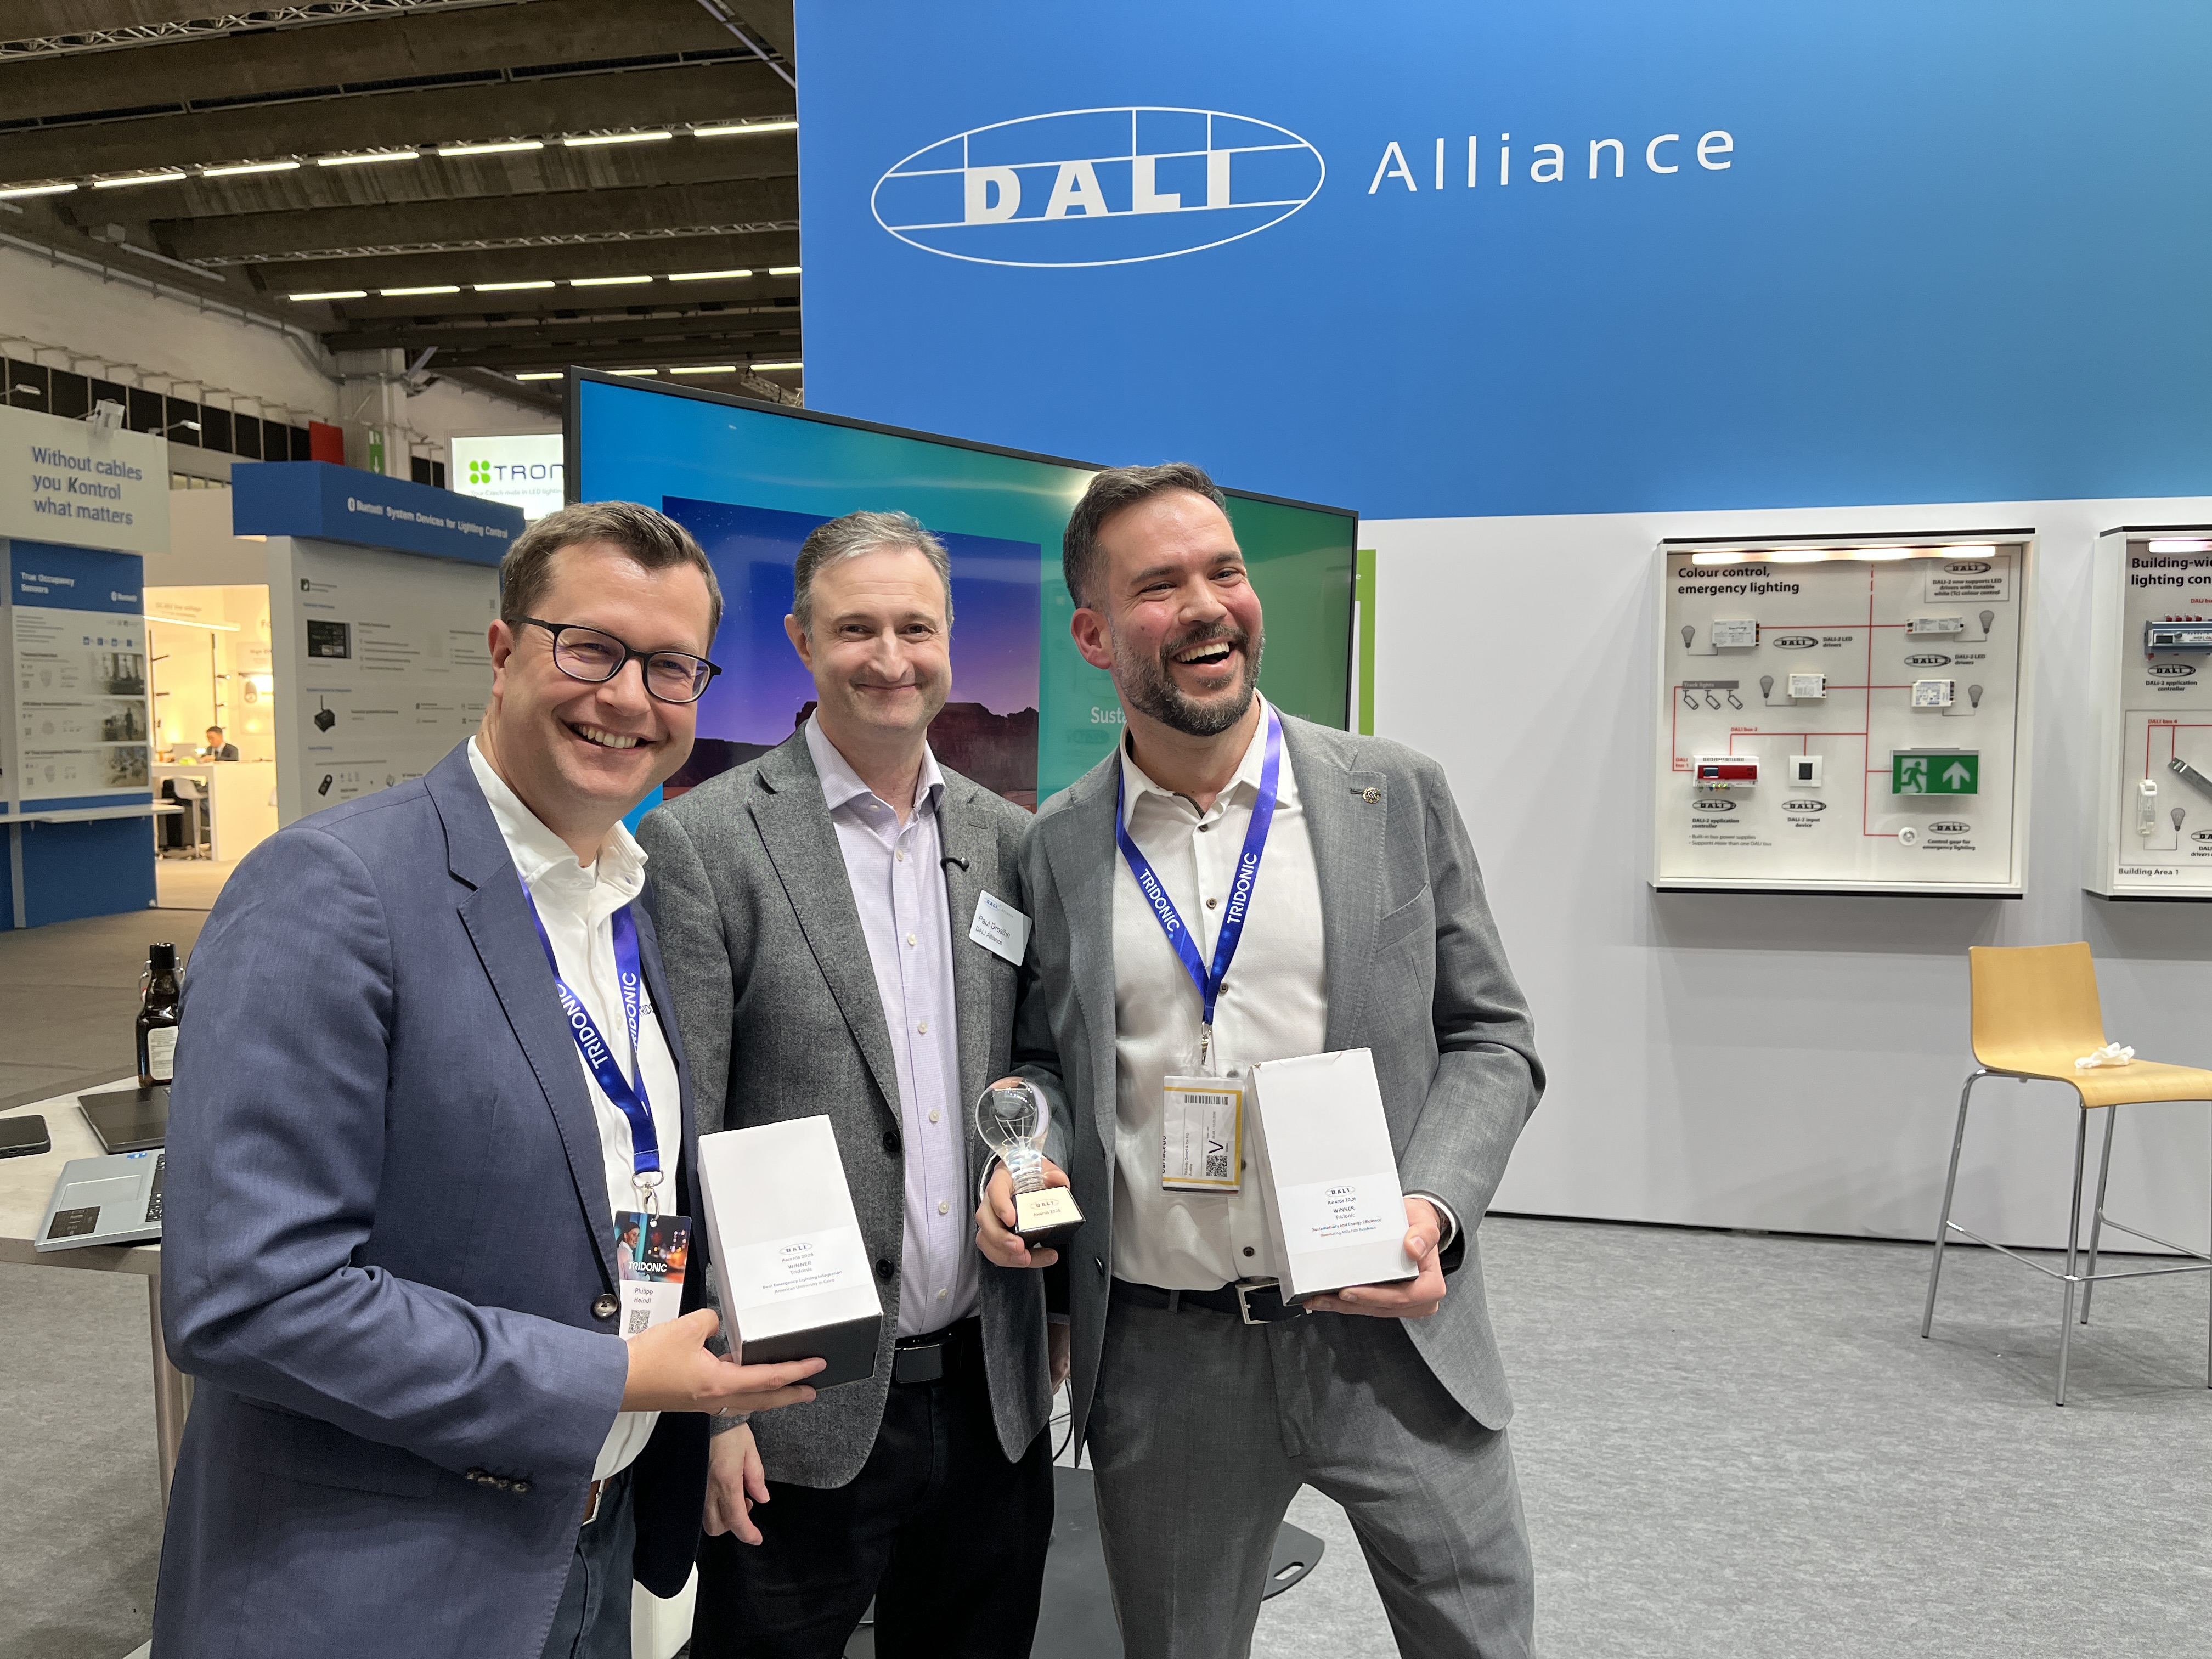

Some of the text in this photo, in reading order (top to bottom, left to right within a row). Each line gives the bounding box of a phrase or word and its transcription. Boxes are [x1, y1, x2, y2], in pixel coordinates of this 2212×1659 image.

[964, 130, 1734, 224] DALI Alliance
[32, 446, 143, 481] Without cables
[33, 475, 121, 500] you Kontrol
[33, 496, 134, 525] what matters
[386, 506, 415, 521] System
[416, 512, 444, 527] Devices
[446, 518, 455, 529] for
[458, 521, 484, 537] Lighting
[485, 526, 509, 539] Control
[2132, 556, 2212, 570] Building-wi
[1678, 566, 1770, 578] Colour control,
[2131, 574, 2211, 587] lighting con
[1678, 582, 1800, 596] emergency lighting
[2118, 868, 2152, 877] Building
[1227, 853, 1257, 924] TRIDONIC
[1139, 868, 1180, 932] TRIDONIC
[978, 915, 991, 927] Paul
[975, 926, 1003, 946] DALI Alliance
[1208, 1139, 1224, 1154] V
[786, 1245, 806, 1253] DALI
[628, 1261, 668, 1273] TRIDONIC
[787, 1261, 812, 1269] WINNER
[790, 1267, 812, 1275] Tridonic
[773, 1279, 798, 1288] Emergency
[818, 1270, 843, 1279] Integration
[796, 1282, 818, 1290] University
